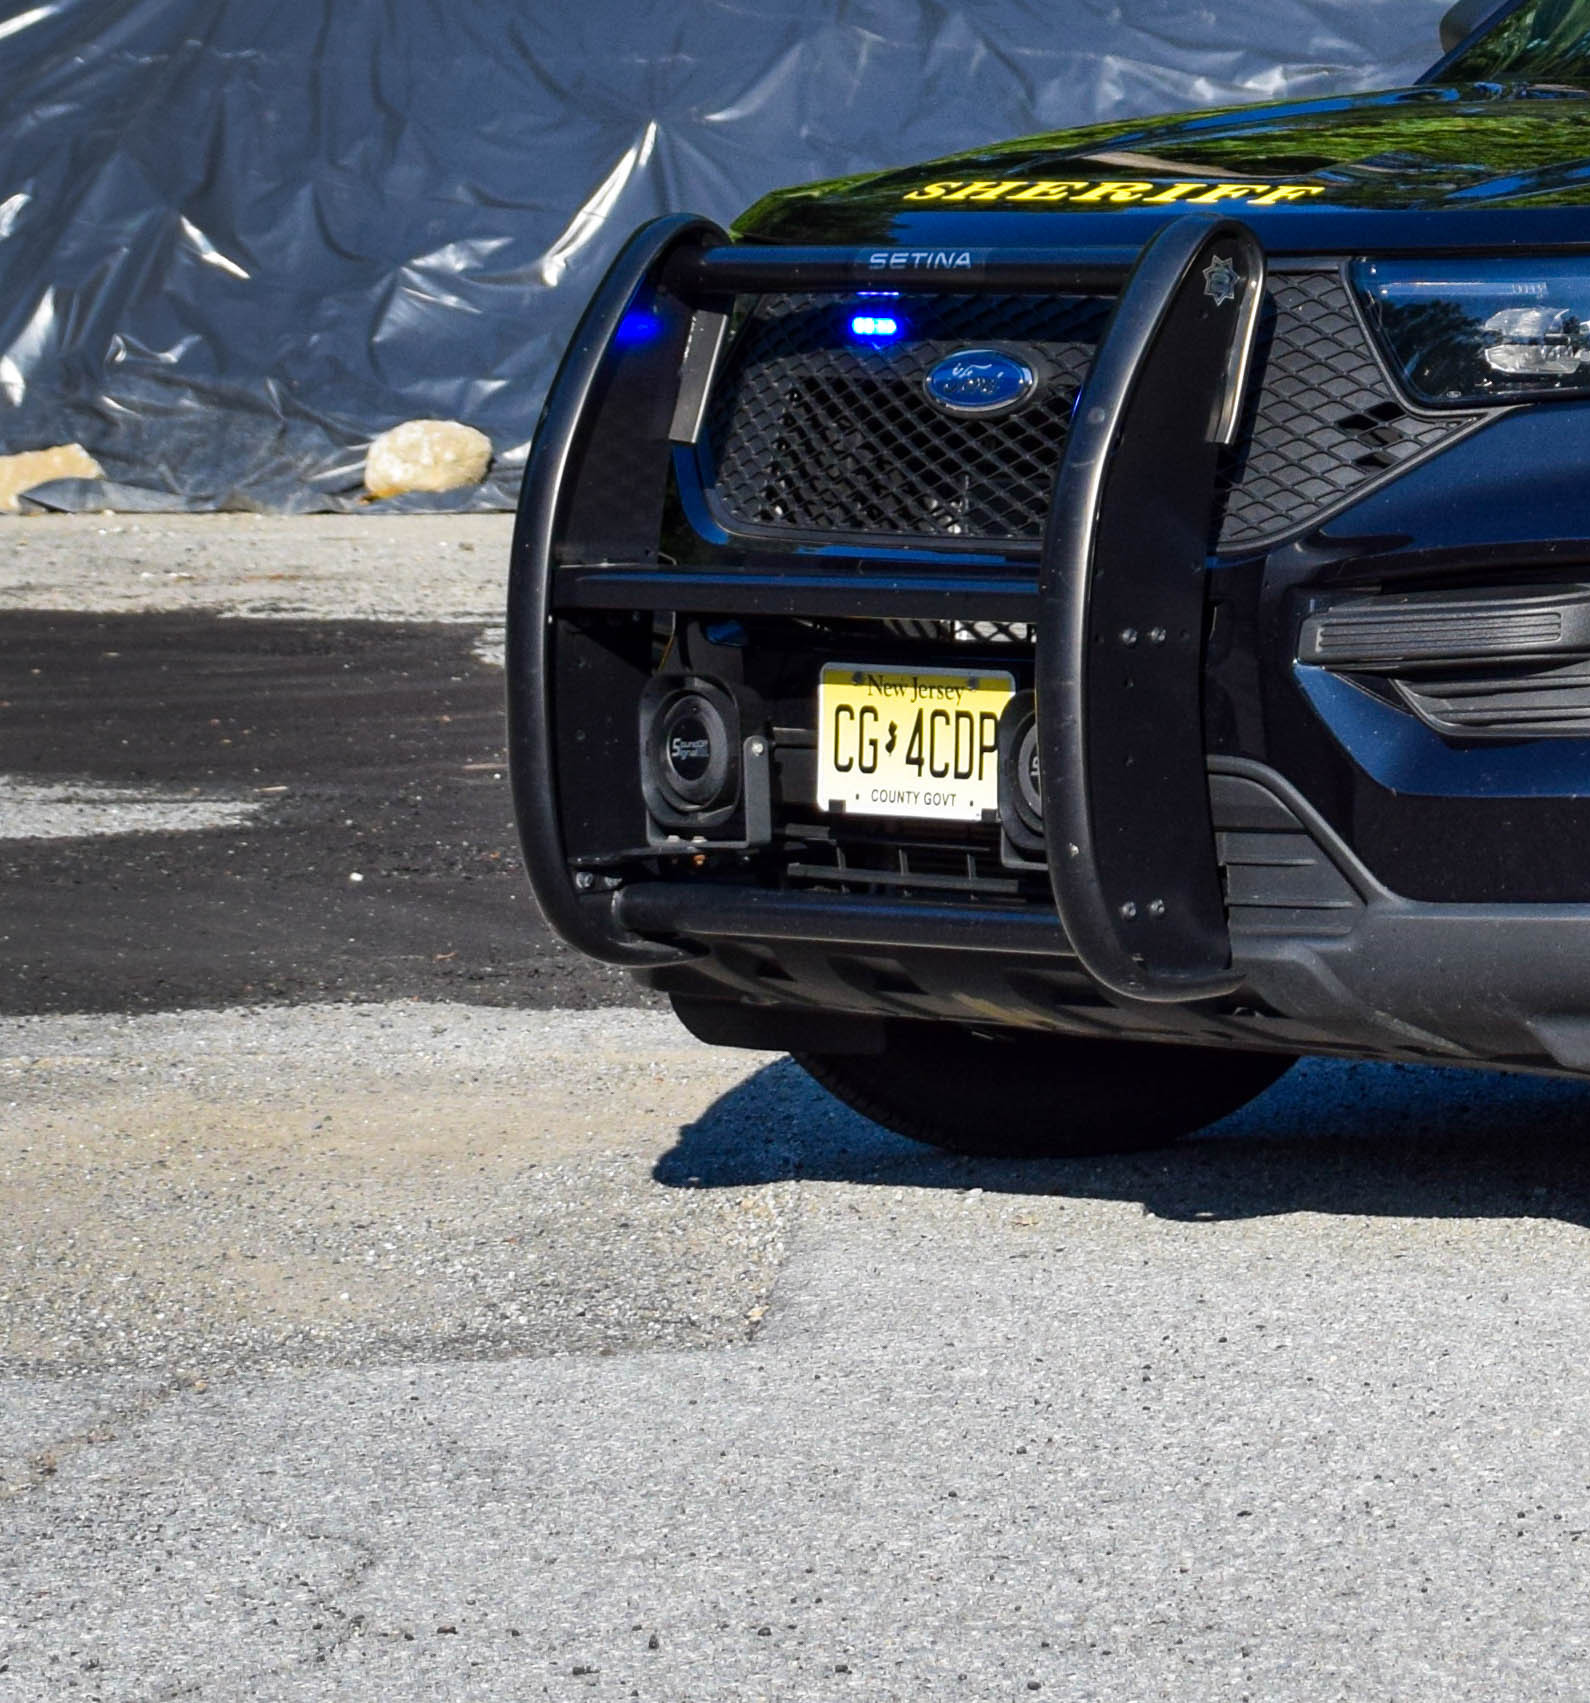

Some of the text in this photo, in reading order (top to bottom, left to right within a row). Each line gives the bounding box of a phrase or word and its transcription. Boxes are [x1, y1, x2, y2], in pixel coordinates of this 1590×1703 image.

[903, 181, 1326, 204] SHERIFF
[869, 253, 972, 270] SETINA
[867, 675, 963, 705] New Jersey
[834, 704, 878, 774] CG
[871, 788, 957, 807] COUNTY GOVT
